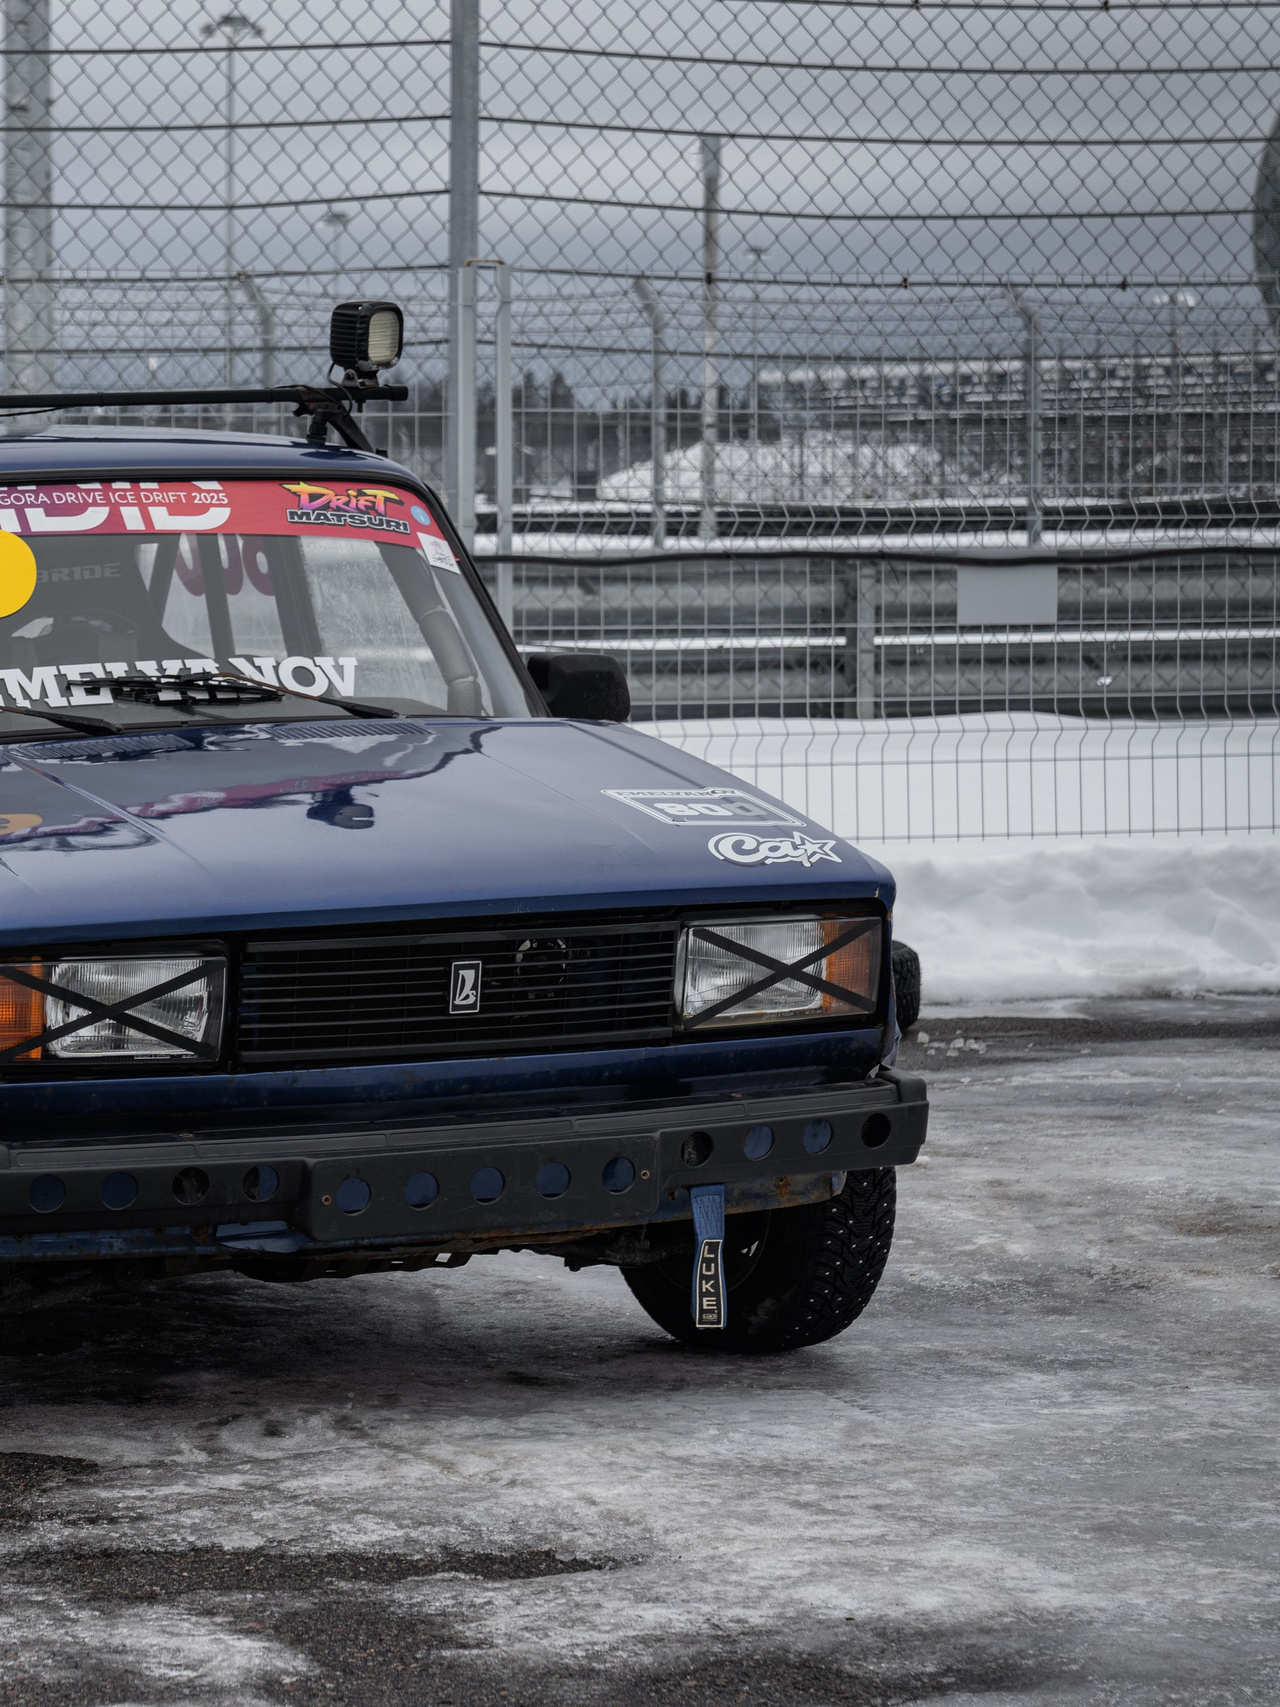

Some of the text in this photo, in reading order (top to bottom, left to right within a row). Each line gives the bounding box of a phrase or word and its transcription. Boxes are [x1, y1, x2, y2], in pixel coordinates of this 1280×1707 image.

[52, 491, 106, 504] DRIVE
[109, 491, 138, 504] ICE
[140, 491, 187, 504] DRIFT
[191, 492, 229, 504] 2025
[286, 508, 411, 534] MATSURI
[653, 801, 768, 817] 800
[702, 1246, 717, 1309] LUKE
